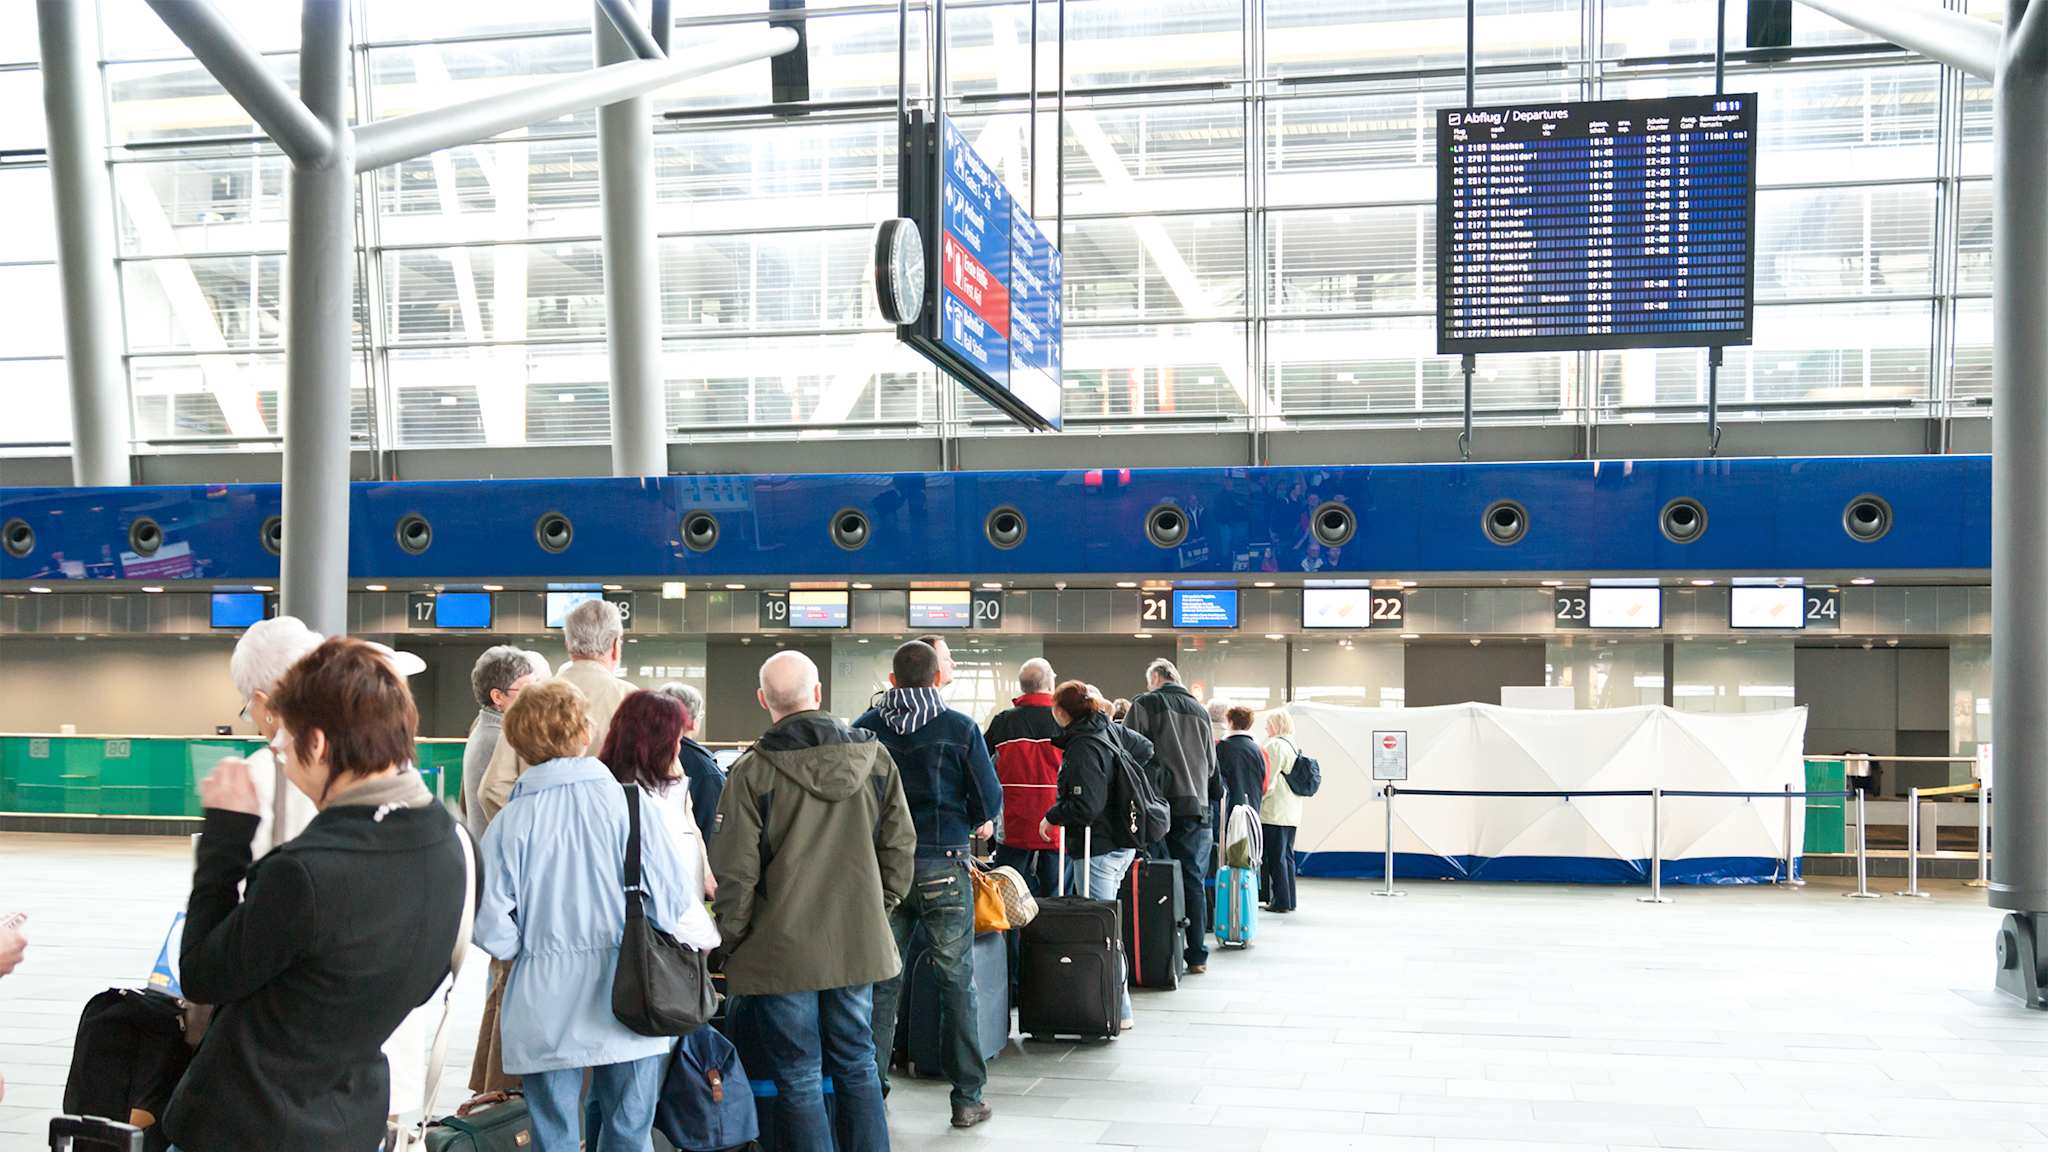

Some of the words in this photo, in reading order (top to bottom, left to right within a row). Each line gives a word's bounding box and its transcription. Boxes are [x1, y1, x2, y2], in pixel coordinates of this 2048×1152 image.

[1464, 112, 1501, 124] Abflug
[1502, 110, 1510, 123] /
[1512, 110, 1568, 122] Departures
[1646, 168, 1669, 176] 22-23
[415, 602, 434, 620] 17
[766, 601, 786, 621] 19
[975, 600, 999, 620] 20
[1143, 600, 1166, 620] 21
[1374, 598, 1401, 620] 22
[1557, 599, 1586, 619] 23
[1807, 599, 1837, 619] 24
